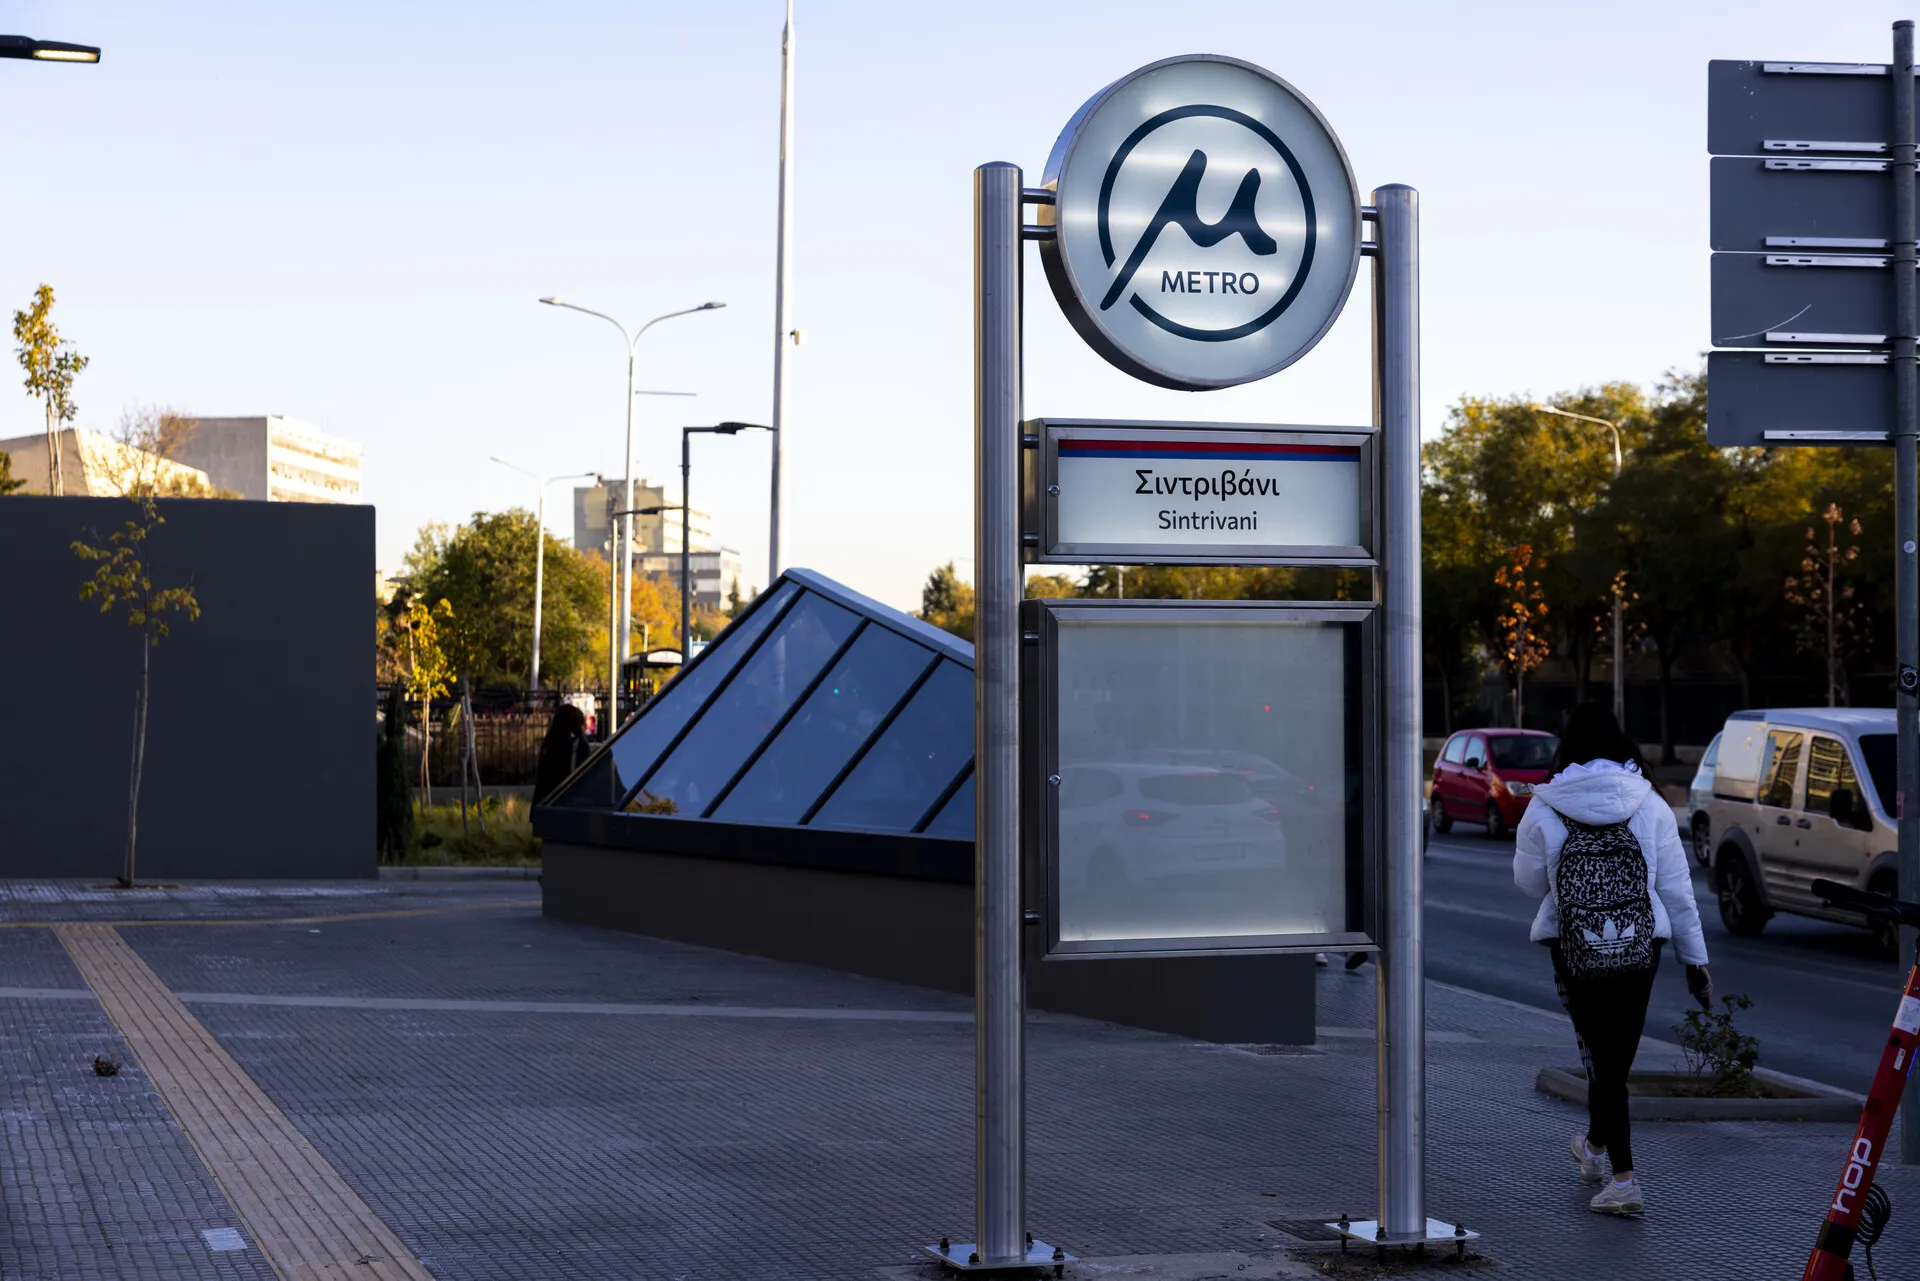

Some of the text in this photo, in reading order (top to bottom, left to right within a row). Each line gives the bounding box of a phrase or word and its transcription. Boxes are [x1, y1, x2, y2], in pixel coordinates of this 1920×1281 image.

[1161, 270, 1260, 295] METRO
[1135, 468, 1280, 501] Σιντριβάνι
[1158, 510, 1257, 530] Sintrivani
[1586, 955, 1640, 969] adidas
[1832, 1137, 1872, 1214] hop
